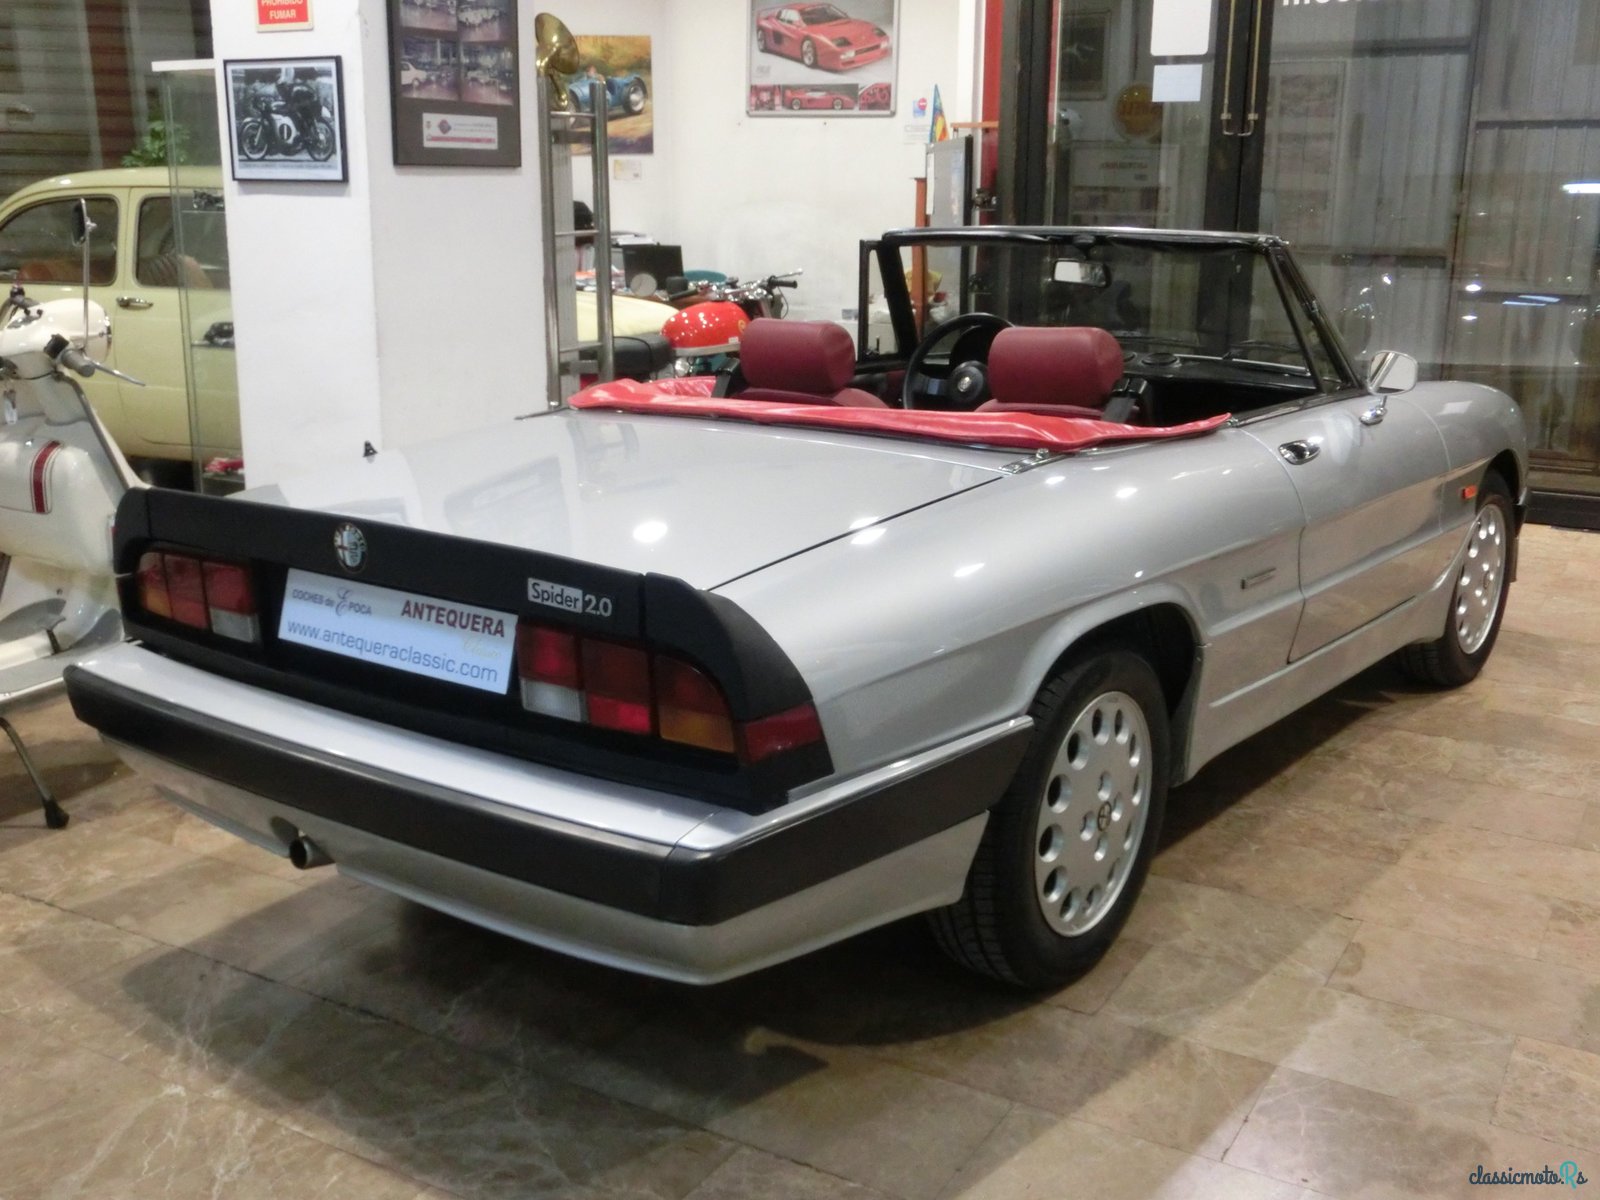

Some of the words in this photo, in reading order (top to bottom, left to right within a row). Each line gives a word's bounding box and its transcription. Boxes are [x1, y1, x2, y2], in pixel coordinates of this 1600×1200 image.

[269, 9, 297, 20] FUMAR
[531, 582, 580, 609] Spider
[585, 594, 612, 617] 2.0
[401, 600, 504, 638] ANTEQUERA
[287, 620, 498, 682] www.antequeraclassic.com
